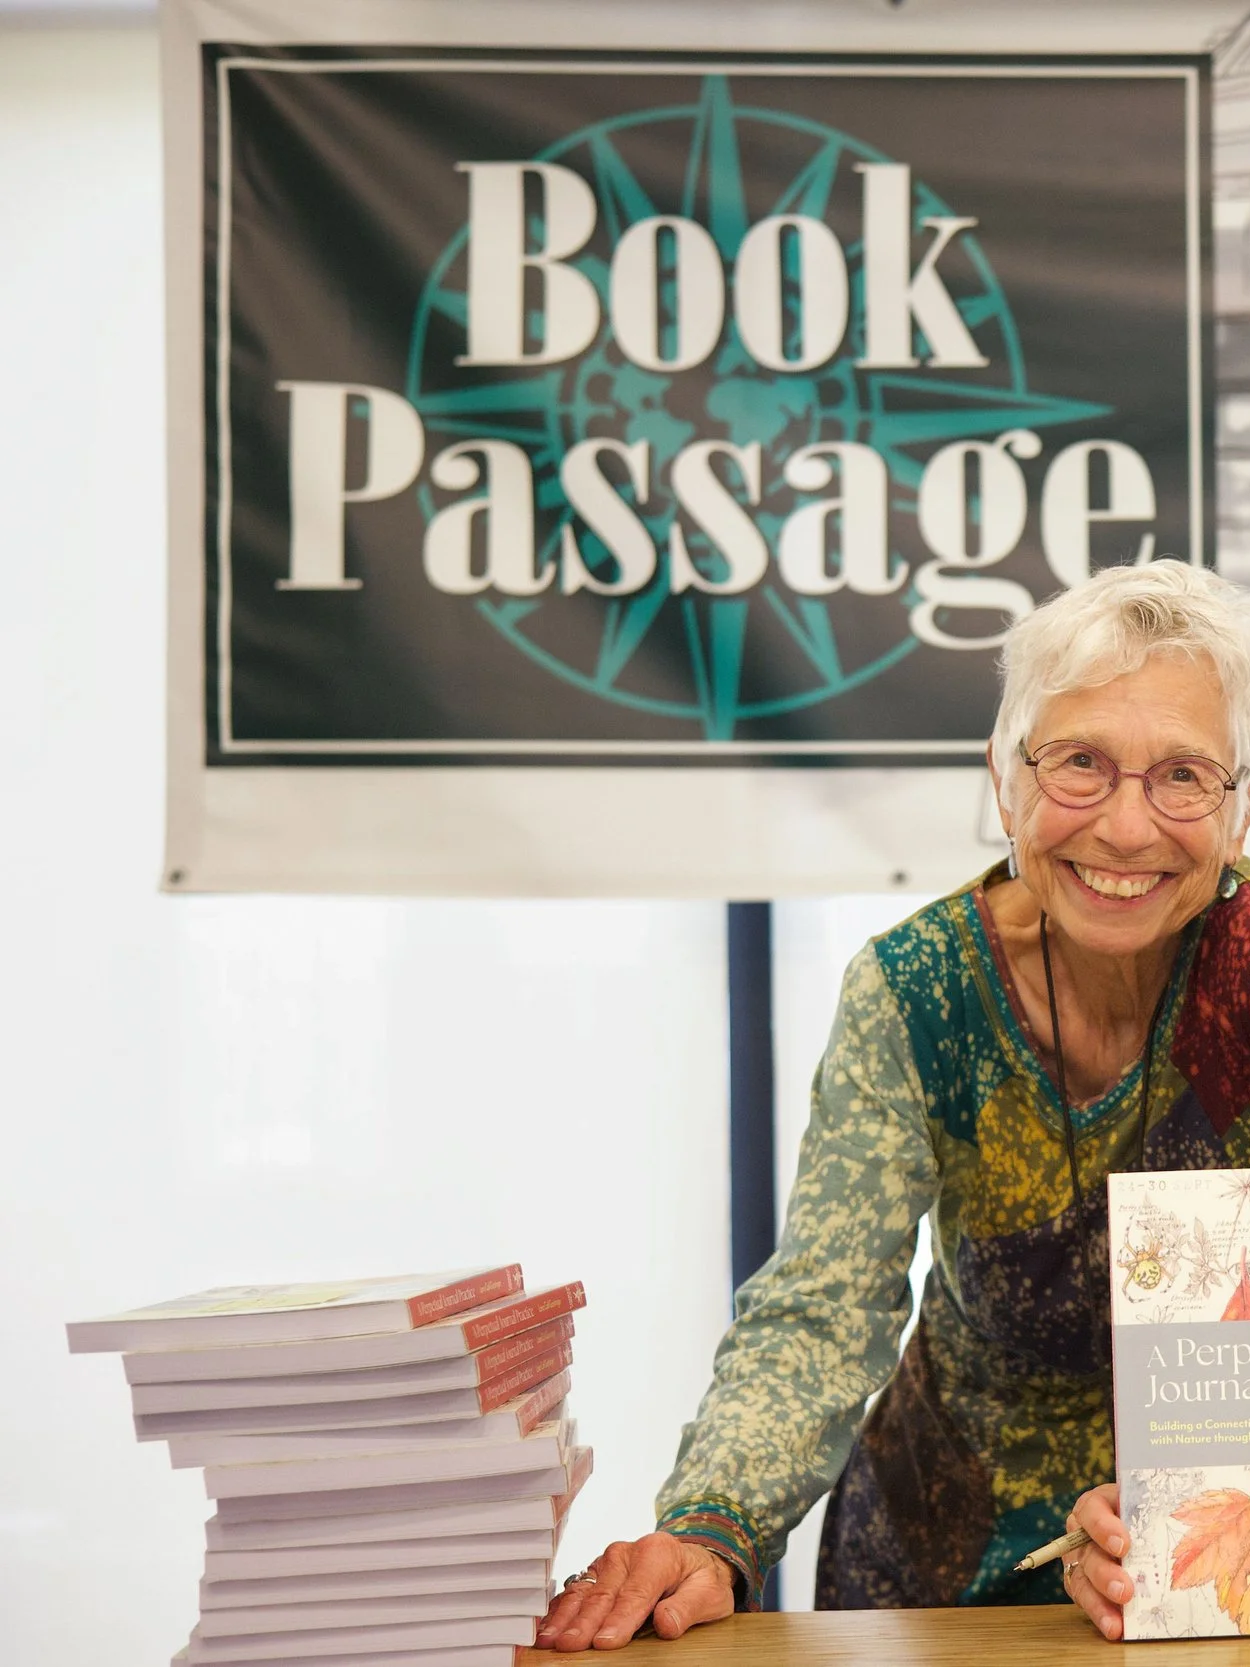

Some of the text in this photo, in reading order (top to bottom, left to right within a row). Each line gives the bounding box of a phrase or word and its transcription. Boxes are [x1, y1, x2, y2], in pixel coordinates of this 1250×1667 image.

[455, 159, 990, 373] Book
[274, 379, 1158, 651] Passage
[1146, 1346, 1168, 1369] A
[1150, 1420, 1194, 1433] Building
[1195, 1423, 1203, 1431] a
[1150, 1435, 1173, 1446] with
[1175, 1433, 1212, 1445] Nature
